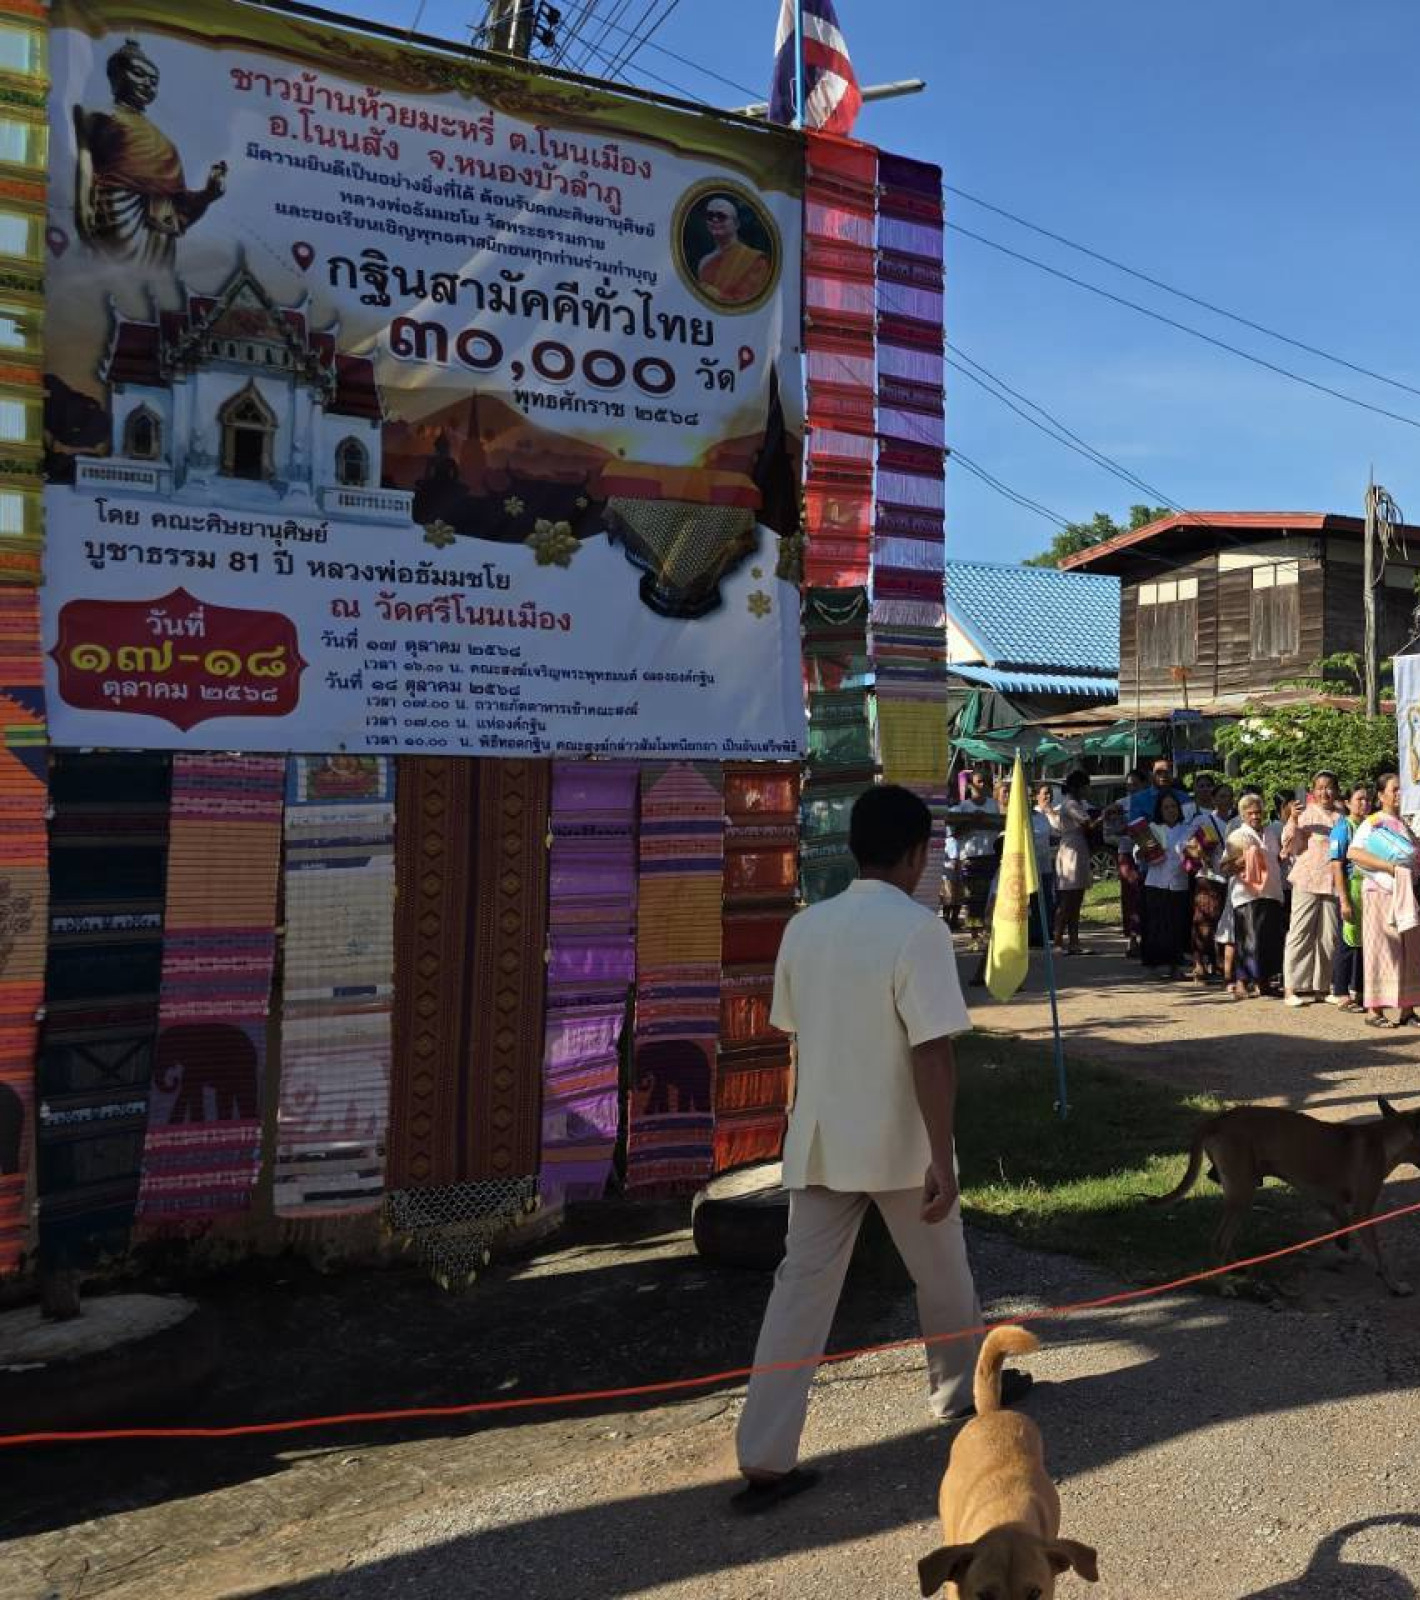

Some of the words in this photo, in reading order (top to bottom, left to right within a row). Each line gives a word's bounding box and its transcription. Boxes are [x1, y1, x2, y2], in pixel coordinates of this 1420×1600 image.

[269, 108, 399, 160] อ.โนนสัง
[427, 149, 622, 215] จ.หนองบัวลำภู
[509, 124, 652, 180] ต.โนนเมือง
[485, 213, 605, 250] วัดพระธรรมกาย
[328, 249, 714, 347] กฐินสามัคคีทั่วไทย
[390, 316, 676, 395] ๓๐,๐๐๐
[695, 357, 735, 393] วัด
[514, 387, 625, 418] พุทธศักราช
[635, 404, 699, 427] ๒๕๖๘
[95, 497, 139, 526] โดย
[151, 512, 328, 547] คณะศิษยานุศิษย์
[84, 539, 216, 570] บูชาธรรม
[229, 551, 259, 574] 81
[274, 549, 293, 576] ปี
[306, 558, 511, 591] หลวงพ่อธัมมชโย
[146, 605, 206, 637] วันที่
[331, 598, 361, 619] ณ
[375, 590, 572, 631] วัดศรีโนนเมือง
[70, 640, 287, 678] ๑๗-๑๘
[321, 628, 359, 650] วันที่
[366, 640, 397, 652] ๑๗
[405, 640, 461, 658] ตุลาคม
[468, 643, 521, 657] ๒๕๖๘
[103, 680, 188, 706] ตุลาคม
[200, 685, 278, 702] ๒๕๖๘
[325, 669, 363, 690] วันที่
[371, 679, 399, 691] ๑๘
[405, 680, 461, 698] ตุลาคม
[469, 683, 521, 696] ๒๕๖๘
